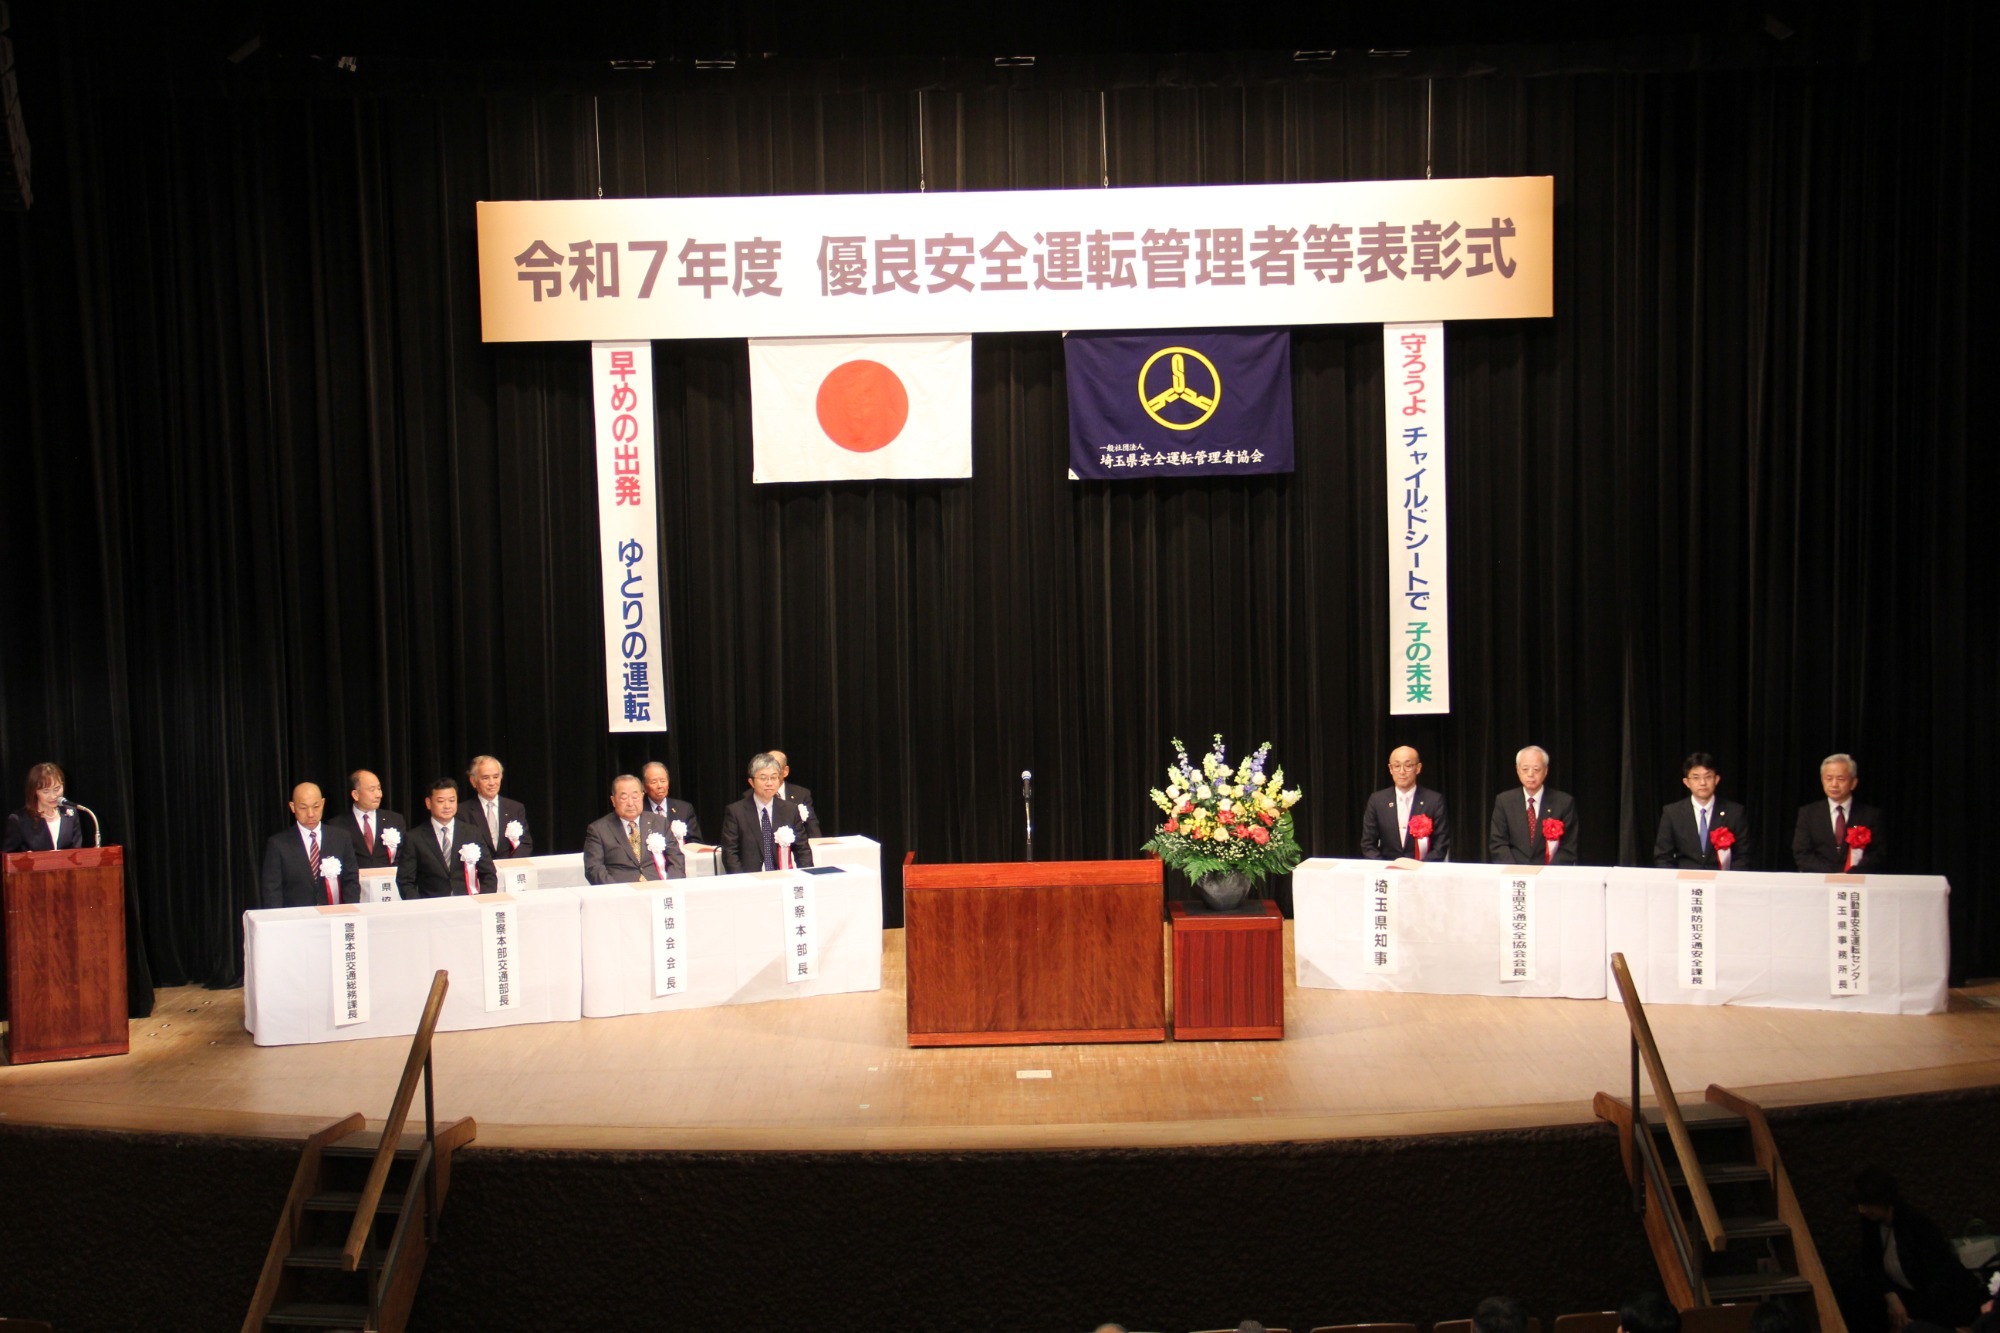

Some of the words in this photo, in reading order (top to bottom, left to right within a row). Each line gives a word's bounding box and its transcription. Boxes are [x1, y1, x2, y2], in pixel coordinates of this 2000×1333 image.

[816, 217, 1516, 297] 優良安全運転管理者等表彰式
[1400, 333, 1427, 417] 守ろうよ
[609, 350, 641, 507] 早めの出発
[1099, 443, 1145, 452] 一般社団法人
[1099, 449, 1265, 469] 埼玉県安全運転管理者協会
[1402, 426, 1430, 611] チャイルドシートで
[618, 537, 651, 723] ゆとりの運転
[1405, 621, 1433, 704] 子の未来
[495, 911, 509, 1006] 警察本部交通部長
[663, 897, 676, 989] 県協会会長
[793, 886, 808, 975] 警察本部長
[1374, 879, 1388, 966] 埼玉県知事
[1512, 880, 1527, 976] 埼玉県交通安全協会会長
[1691, 888, 1704, 985] 埼玉県防犯交通安全課長
[1850, 891, 1860, 989] 自動車安全運転センター
[344, 922, 357, 1019] 警察本部交通総務課長
